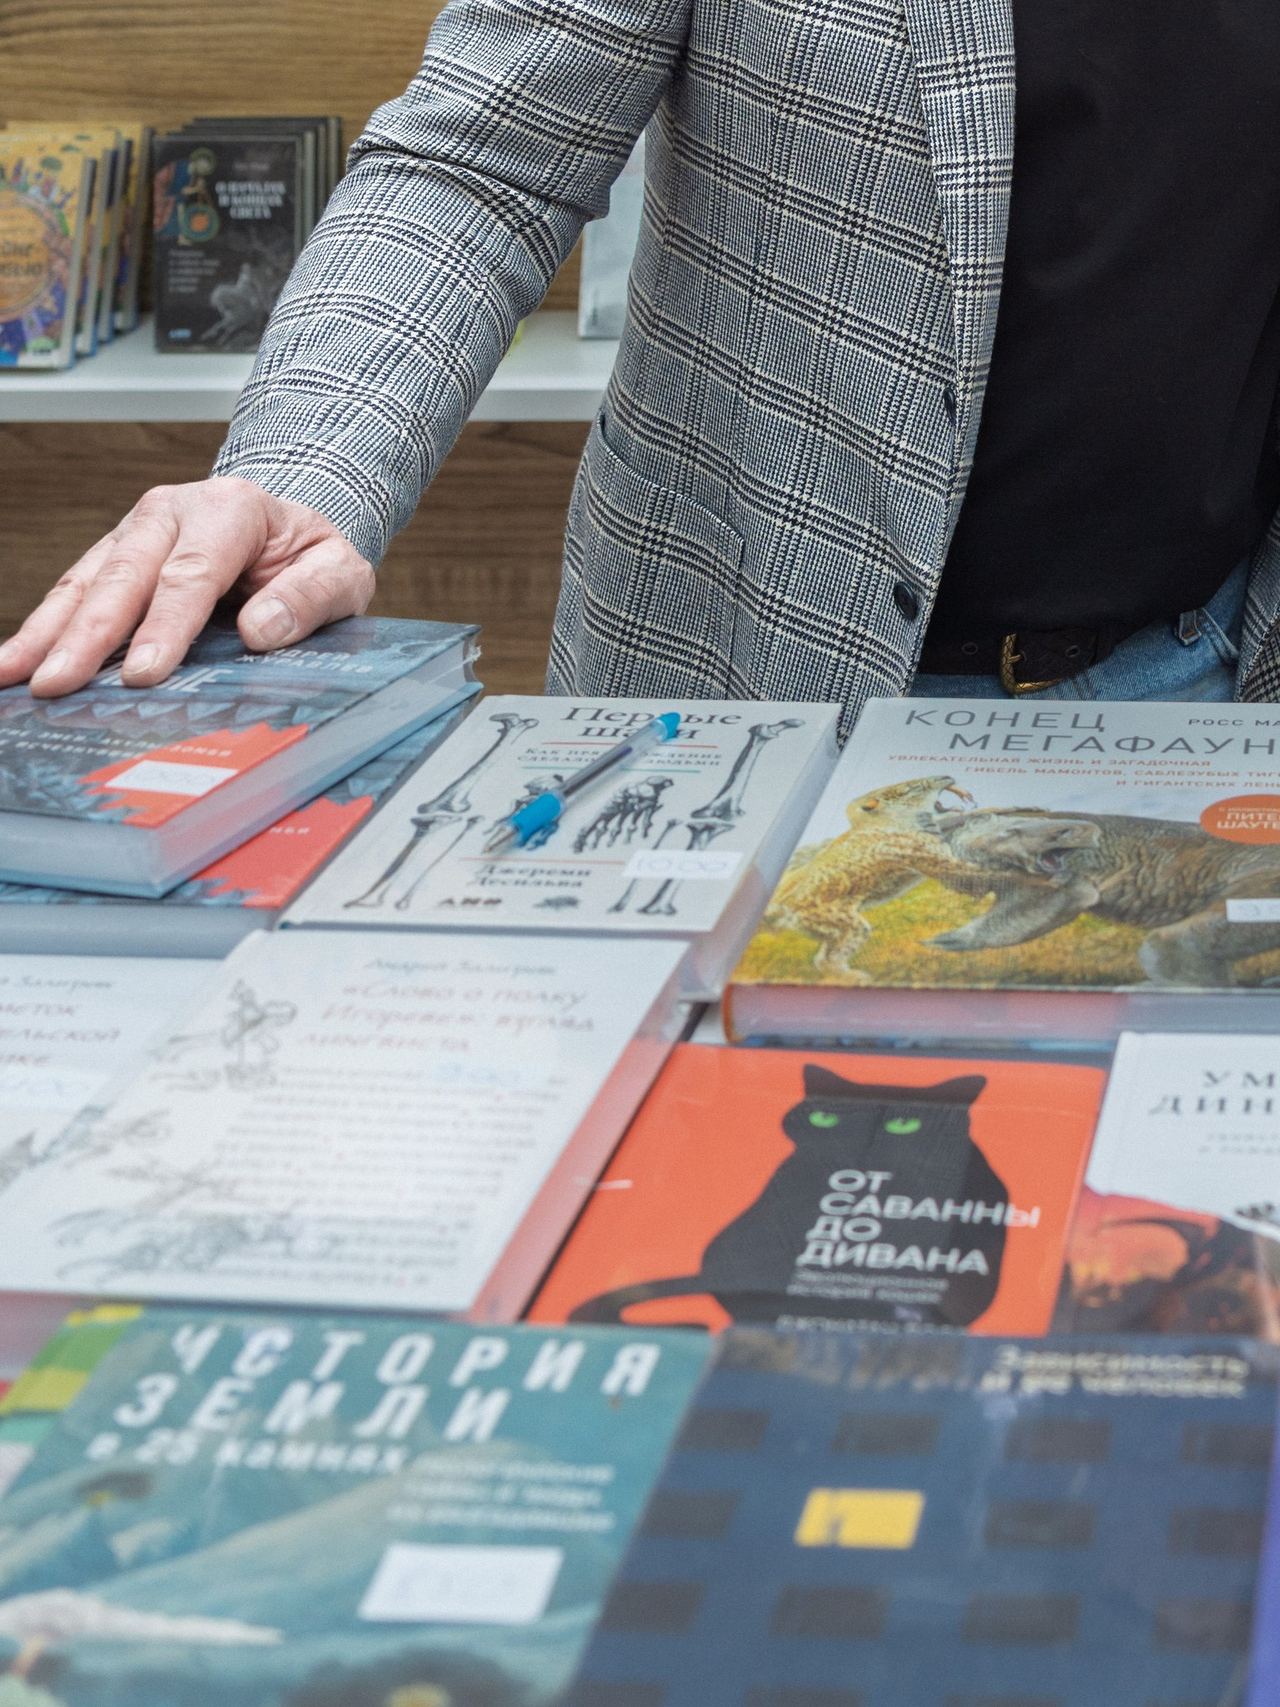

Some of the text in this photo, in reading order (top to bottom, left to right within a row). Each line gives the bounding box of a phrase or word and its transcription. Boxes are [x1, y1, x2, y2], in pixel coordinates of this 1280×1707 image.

[561, 707, 742, 727] Перые
[905, 709, 1105, 733] КОНЕЦ
[1188, 718, 1244, 727] РОСС
[888, 754, 1021, 765] УВЛЕКАТЕЛЬНАЯ
[1026, 758, 1085, 766] ЖИЗНЬ
[1109, 759, 1212, 768] ЗАГАДОЧНАЯ
[964, 766, 1028, 775] ГИБЕЛЬ
[1134, 769, 1240, 780] САБЛЕЗУБЫХ
[1133, 780, 1237, 790] ГИГАНТСКИХ
[828, 1169, 893, 1194] ОТ
[819, 1192, 1041, 1229] САВАННЫ
[806, 1215, 882, 1242] ДО
[796, 1241, 990, 1276] ДИВАНА
[113, 1373, 512, 1443] ЗЕМЛИ
[214, 1437, 410, 1474] камнях
